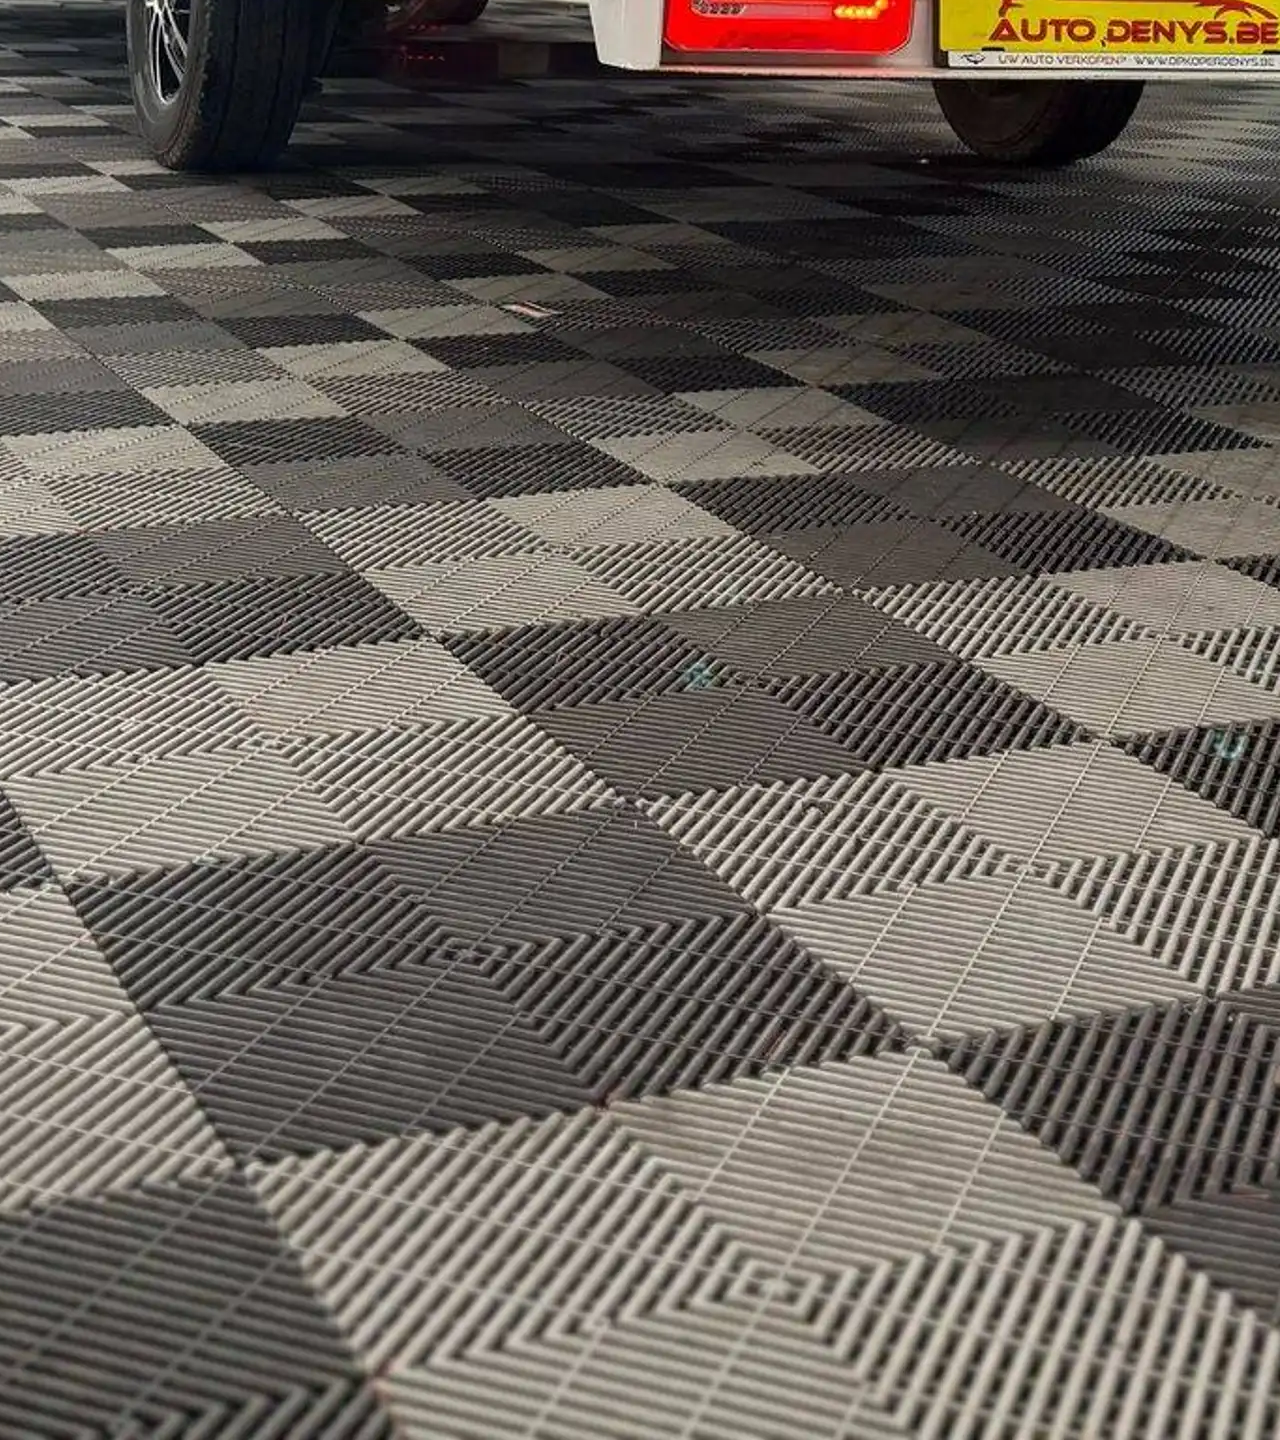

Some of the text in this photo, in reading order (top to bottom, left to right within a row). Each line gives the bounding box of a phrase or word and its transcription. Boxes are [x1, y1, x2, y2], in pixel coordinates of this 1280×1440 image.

[988, 17, 1280, 44] AUTO DENYS.BE
[998, 54, 1019, 65] UW
[1021, 54, 1054, 65] AUTO
